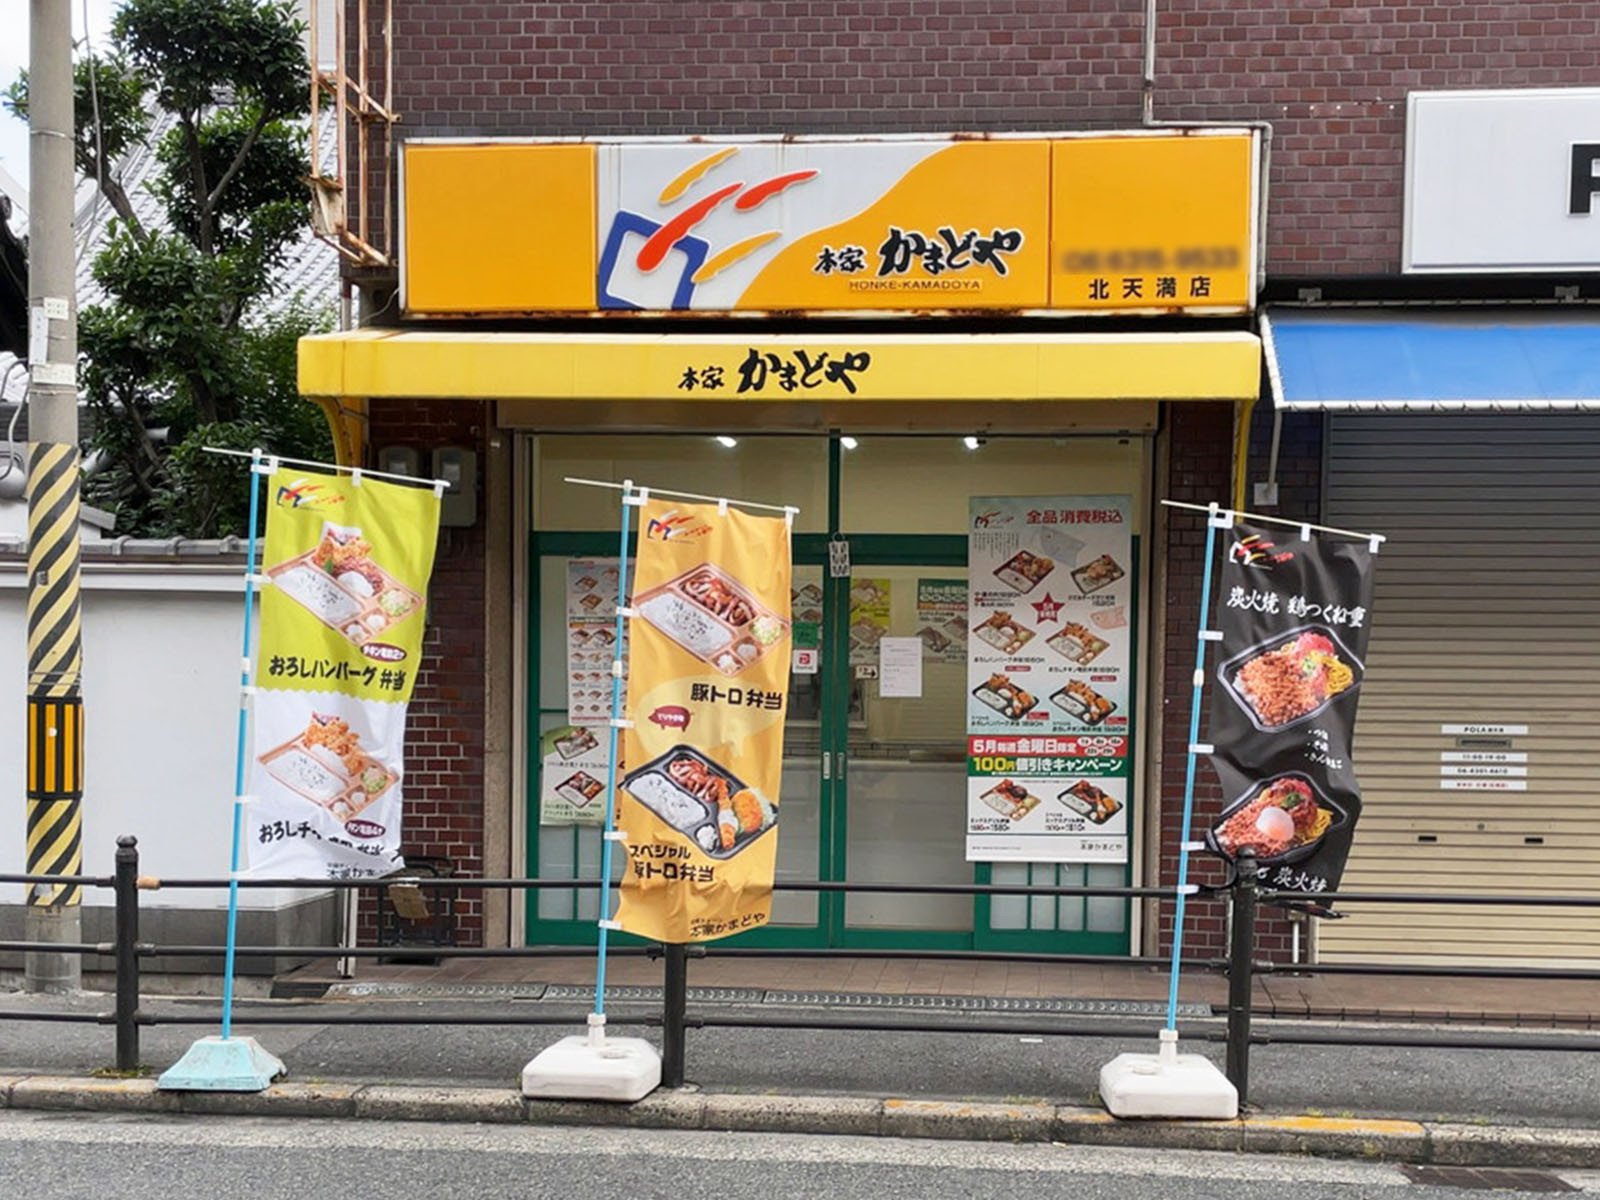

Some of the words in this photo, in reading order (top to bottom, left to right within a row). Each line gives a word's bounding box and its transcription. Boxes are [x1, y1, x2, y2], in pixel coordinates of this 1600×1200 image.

[814, 247, 866, 275] 本家
[878, 227, 1022, 277] かまどや
[849, 280, 981, 290] HONKE-KAMADOYA
[1088, 275, 1210, 300] 北天満店
[678, 366, 724, 391] 本家
[736, 347, 871, 394] かまどや
